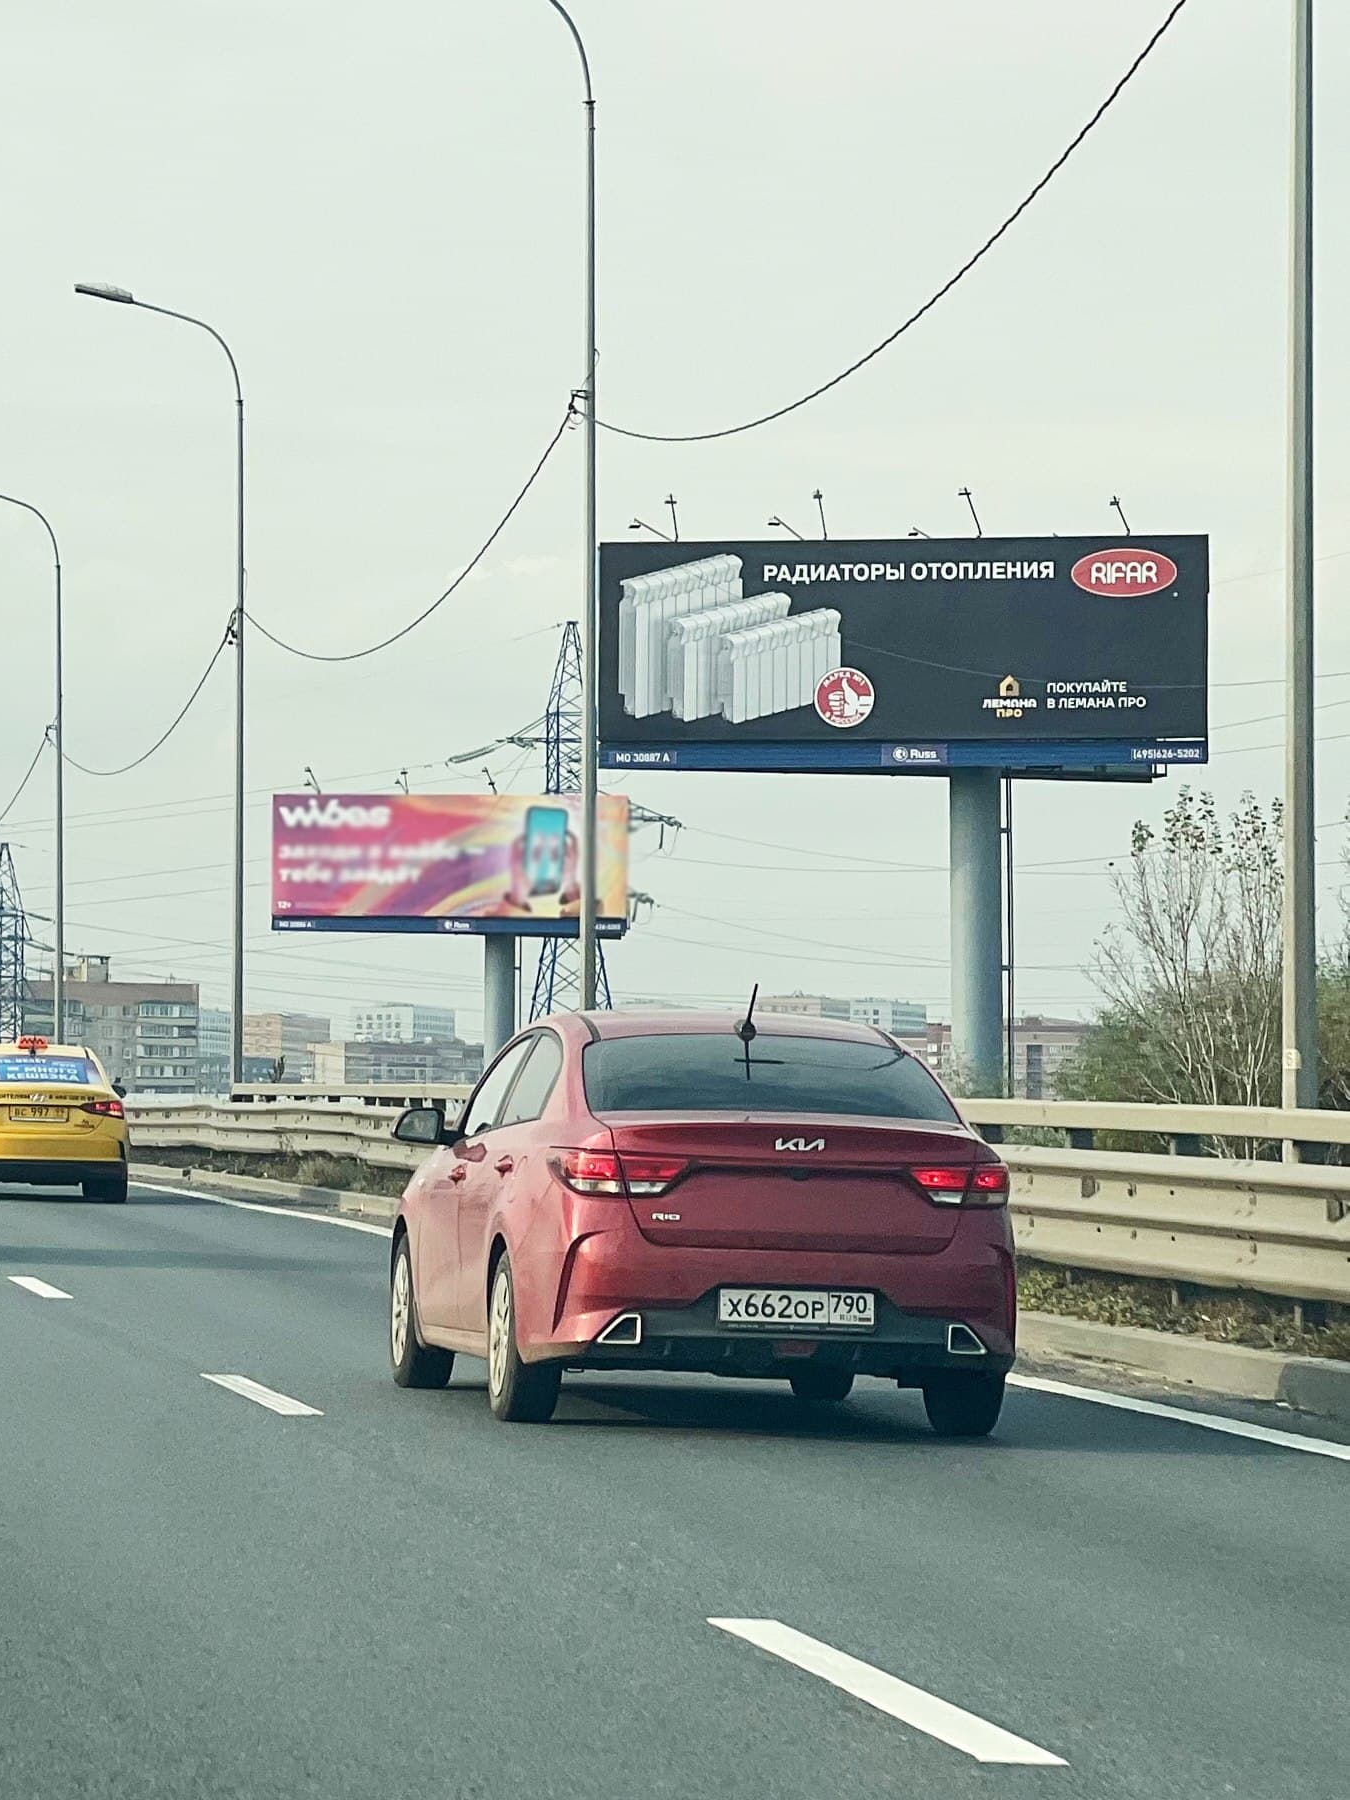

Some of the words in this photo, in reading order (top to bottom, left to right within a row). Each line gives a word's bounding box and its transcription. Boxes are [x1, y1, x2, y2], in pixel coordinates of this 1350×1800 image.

[762, 562, 905, 585] РАДИАТОРЫ
[910, 561, 1055, 581] ОТОПЛЕНИЯ
[1090, 560, 1158, 584] RIFAR
[1046, 679, 1128, 694] ПОКУПАЙТЕ
[982, 698, 1037, 709] ЛЕМАНА
[1046, 698, 1056, 709] В
[1058, 697, 1115, 709] ЛЕМАНА
[1117, 696, 1147, 708] ПРО
[910, 748, 937, 759] Russ
[24, 1066, 78, 1074] МНОГО
[830, 1294, 868, 1314] 790
